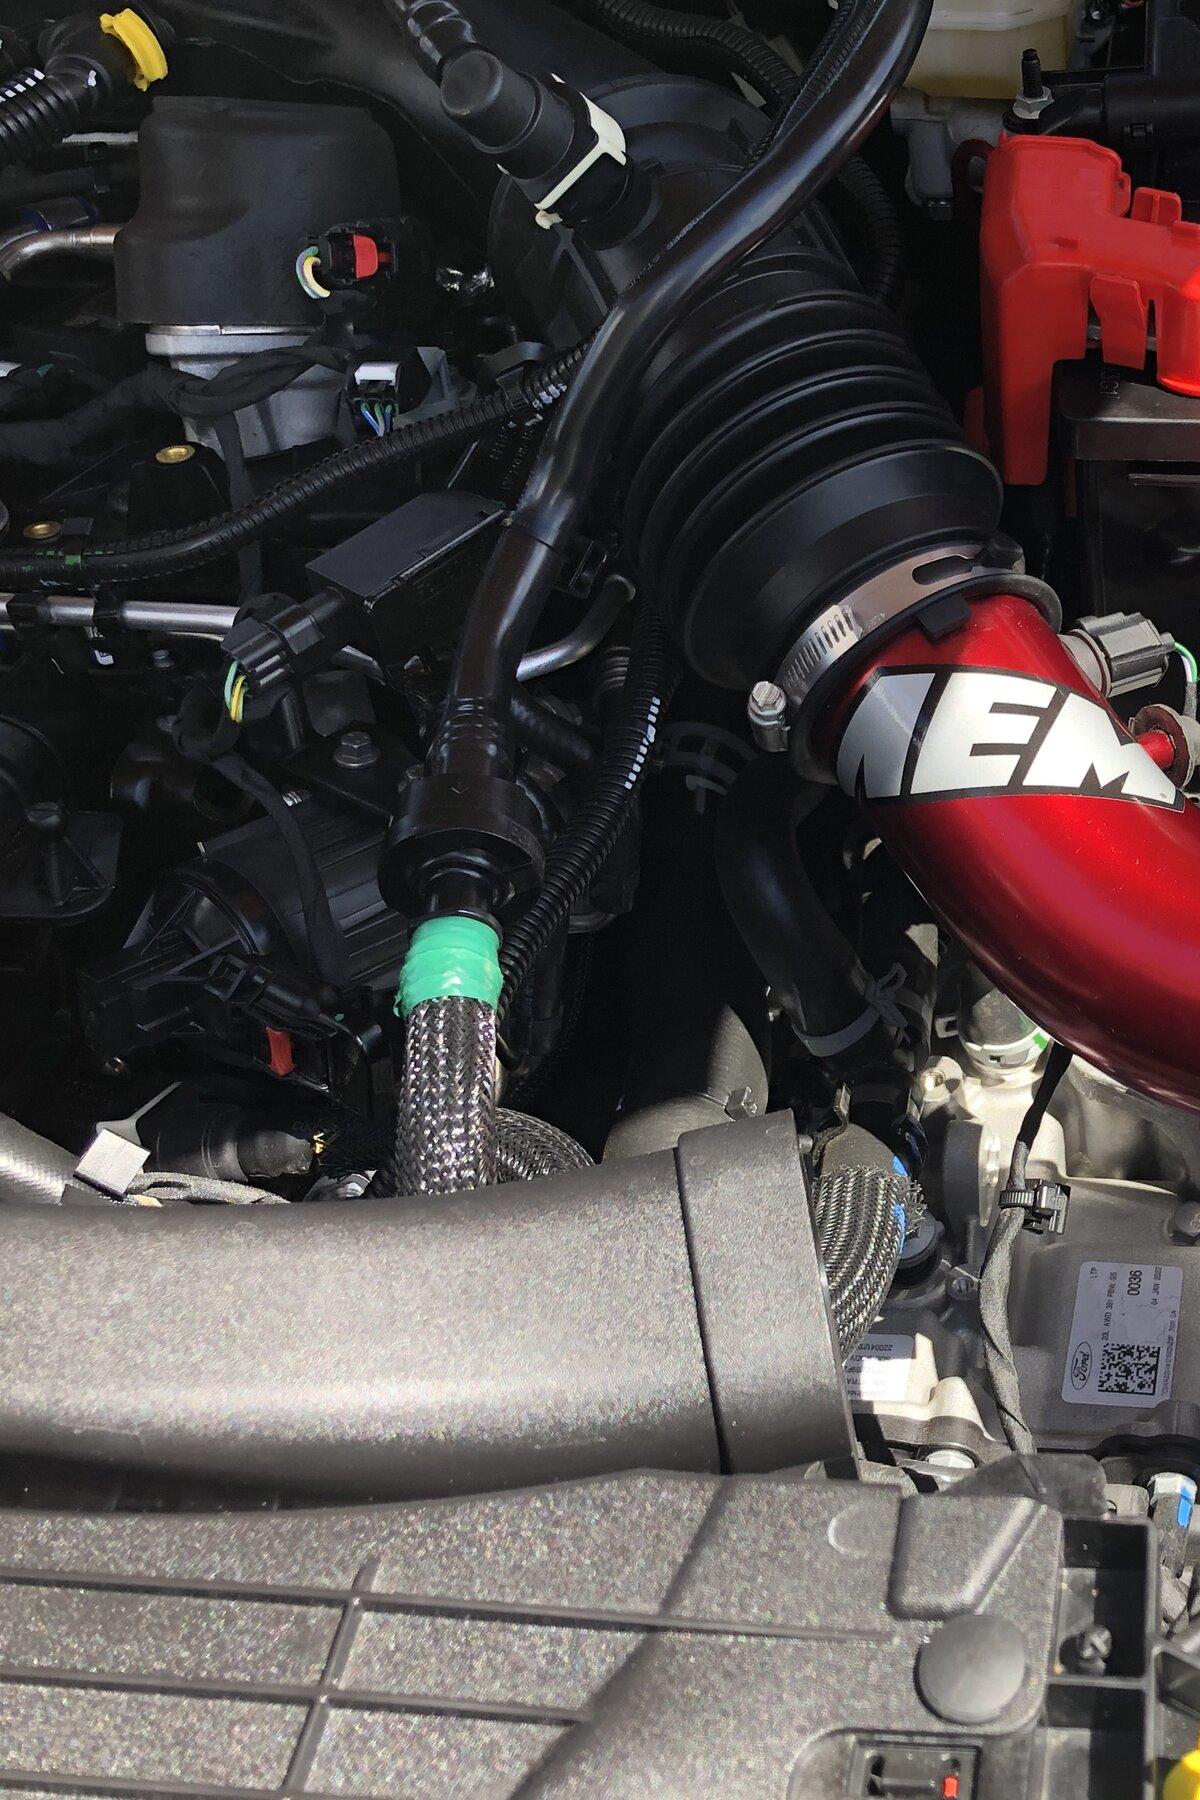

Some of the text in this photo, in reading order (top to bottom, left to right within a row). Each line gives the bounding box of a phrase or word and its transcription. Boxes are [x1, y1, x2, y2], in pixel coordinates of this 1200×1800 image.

[1153, 1267, 1162, 1280] 2022
[1127, 1270, 1142, 1296] 0036
[1152, 1283, 1160, 1295] JAN
[1103, 1312, 1112, 1327] AWD
[1073, 1351, 1089, 1381] Ford
